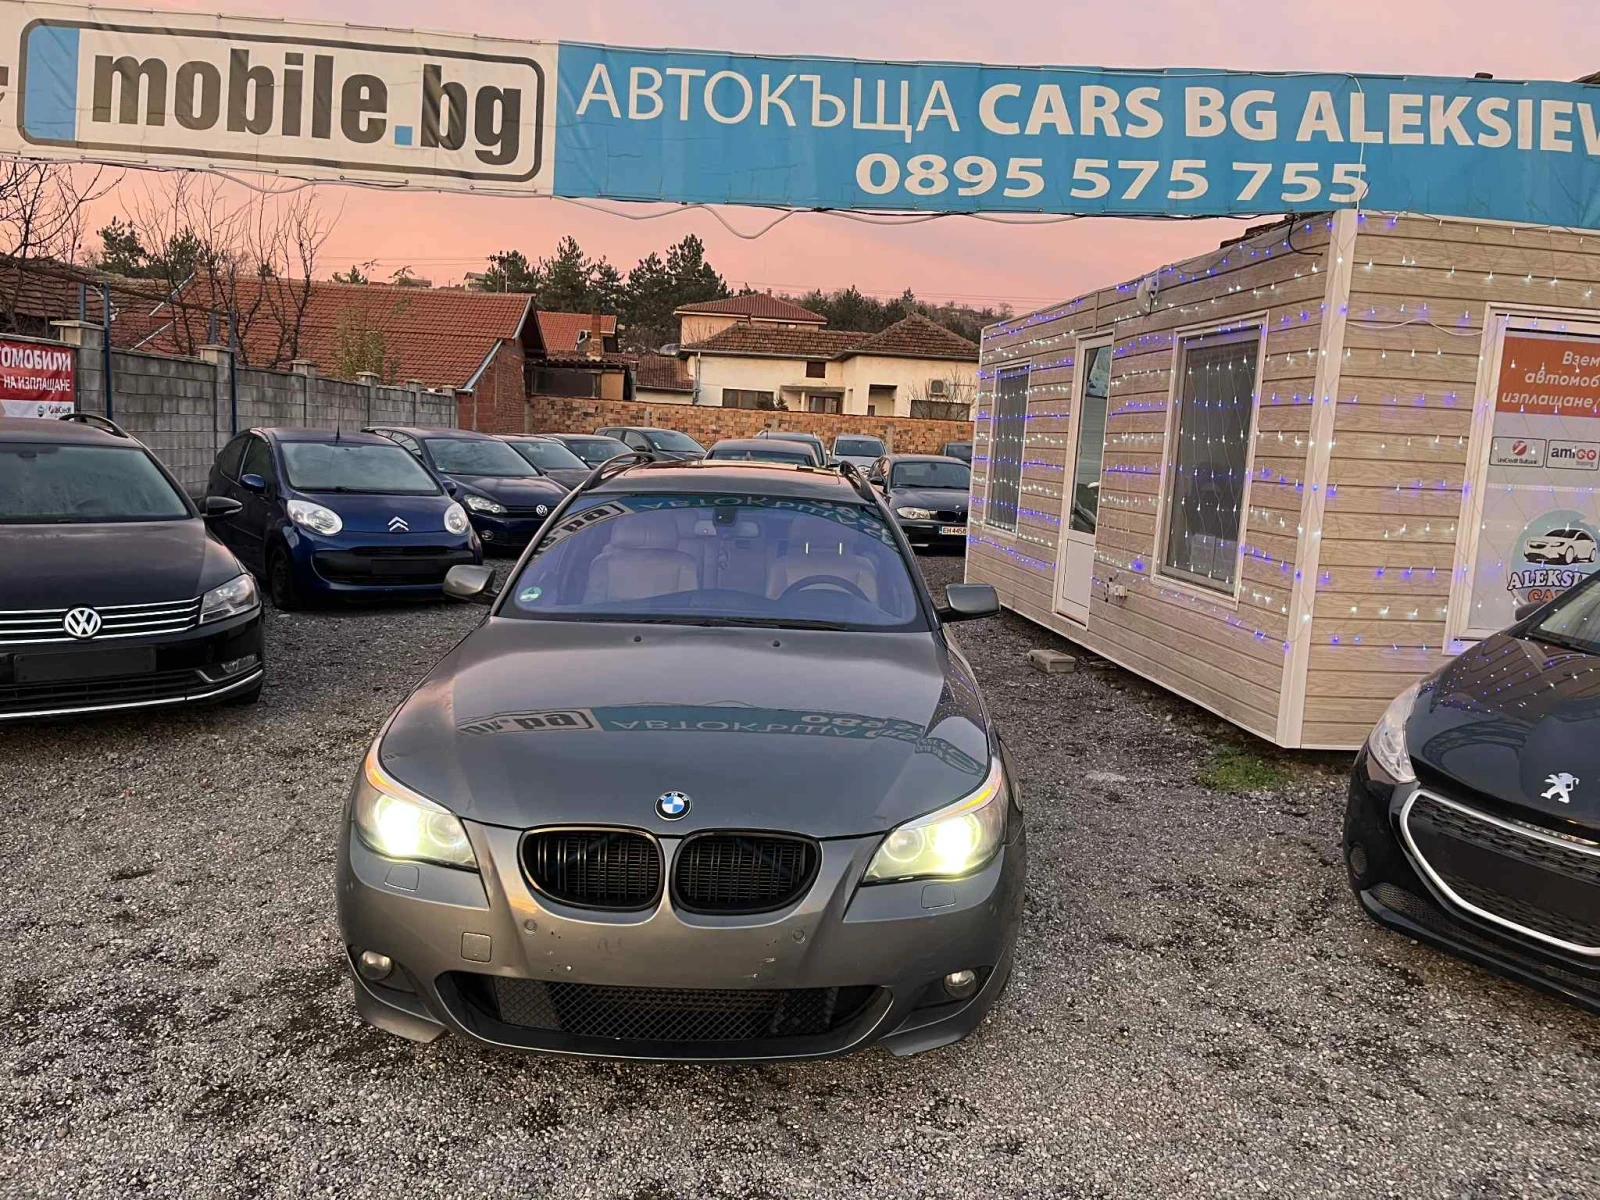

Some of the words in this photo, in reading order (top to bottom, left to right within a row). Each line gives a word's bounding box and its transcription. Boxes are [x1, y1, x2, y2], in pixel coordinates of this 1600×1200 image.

[92, 48, 521, 165] mobile.bg
[576, 63, 960, 143] АВТОКЪЩА
[979, 83, 1164, 138] CARS
[1185, 86, 1277, 142] BG
[855, 153, 1046, 198] 0895
[1070, 158, 1209, 199] 575
[1232, 161, 1369, 203] 755
[0, 347, 71, 371] ОМОБИЛИ
[4, 375, 17, 389] НА
[19, 376, 71, 393] ИЗПЛАЩАНЕ
[1502, 392, 1593, 408] изплащане
